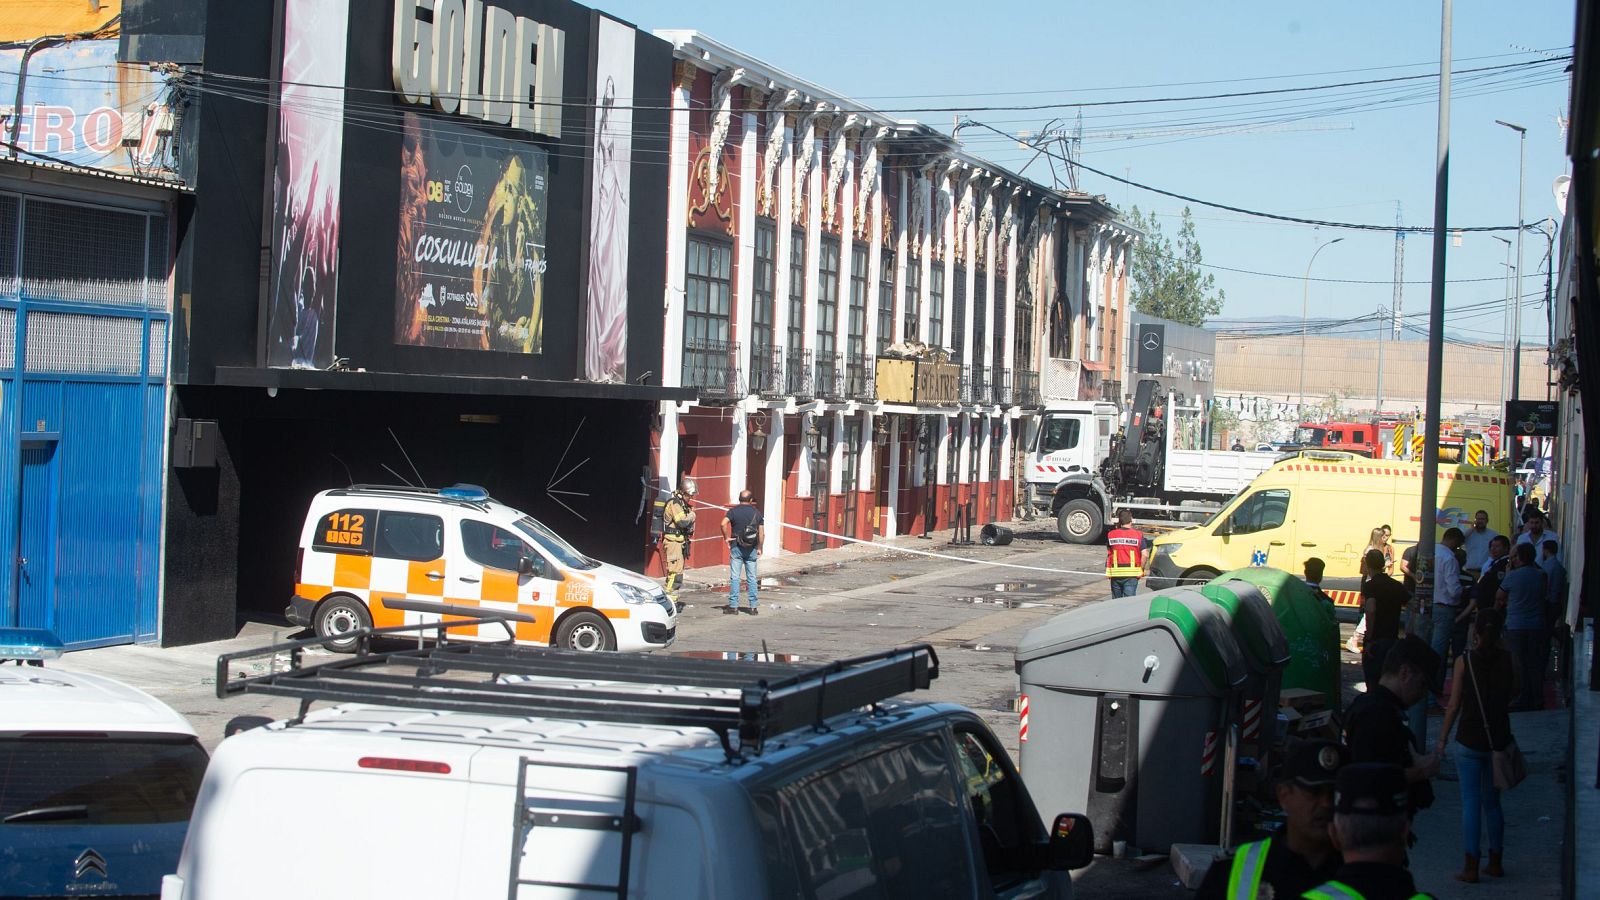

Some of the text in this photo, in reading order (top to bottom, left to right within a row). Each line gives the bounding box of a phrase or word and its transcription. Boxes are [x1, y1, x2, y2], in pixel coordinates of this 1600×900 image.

[392, 0, 565, 139] GOLDEN
[426, 180, 443, 202] 08
[454, 181, 474, 195] GOLDEN
[415, 232, 498, 271] COSCULLUELA
[465, 291, 479, 307] SCS
[328, 512, 365, 532] 112
